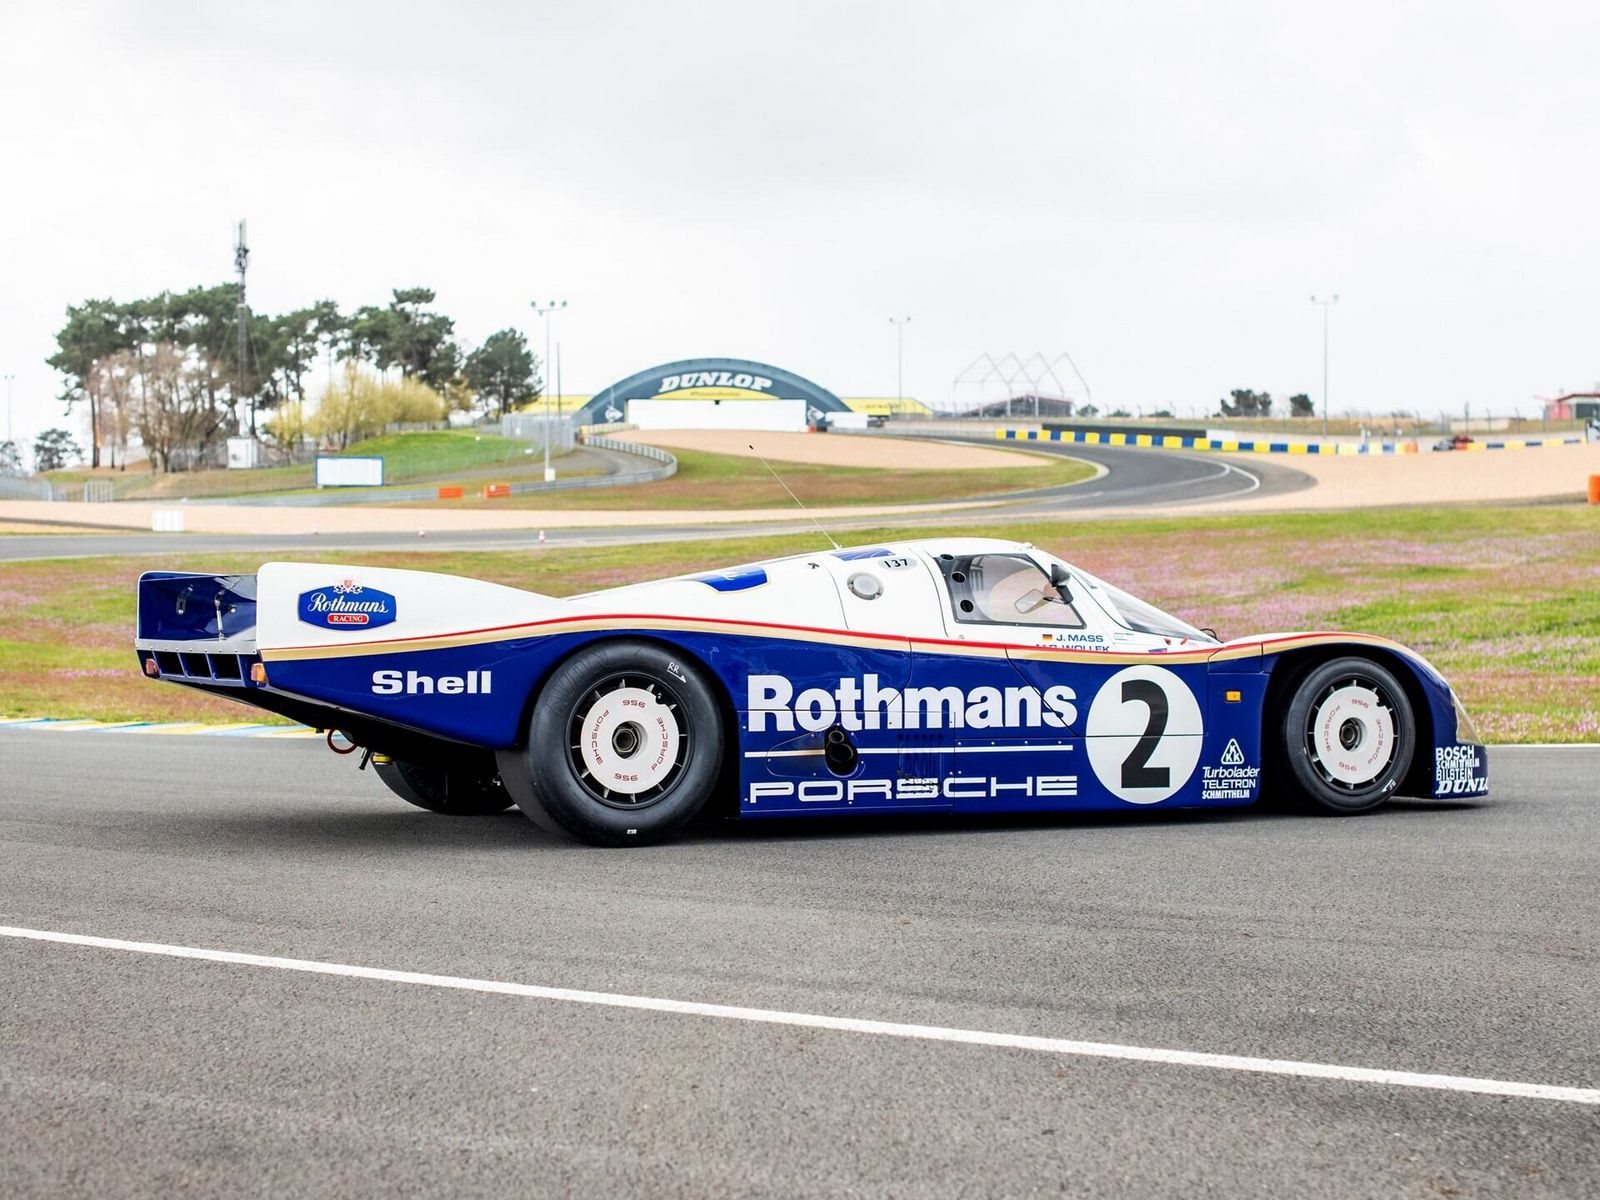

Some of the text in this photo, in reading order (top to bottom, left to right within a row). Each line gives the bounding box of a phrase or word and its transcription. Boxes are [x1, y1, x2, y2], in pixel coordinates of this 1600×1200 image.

[658, 371, 773, 393] DUNLOP
[884, 558, 908, 568] 137
[307, 592, 389, 613] Rothmans
[1056, 634, 1104, 643] J. MASS
[371, 670, 492, 694] Shell
[622, 699, 646, 709] 956
[747, 673, 1078, 732] Rothmans
[1351, 698, 1369, 709] 956
[591, 709, 610, 765] PORSCHE
[1121, 679, 1170, 788] 2
[651, 716, 669, 771] PORSCHE
[1435, 745, 1475, 761] BOSCH
[1202, 765, 1260, 778] Turbolader
[1338, 760, 1357, 771] 956
[614, 772, 638, 782] 956
[1436, 767, 1473, 781] BILSTEIN
[750, 775, 1078, 804] PORSCHE
[1202, 779, 1256, 789] TELETRON
[1202, 789, 1250, 800] SCHMITTHELM
